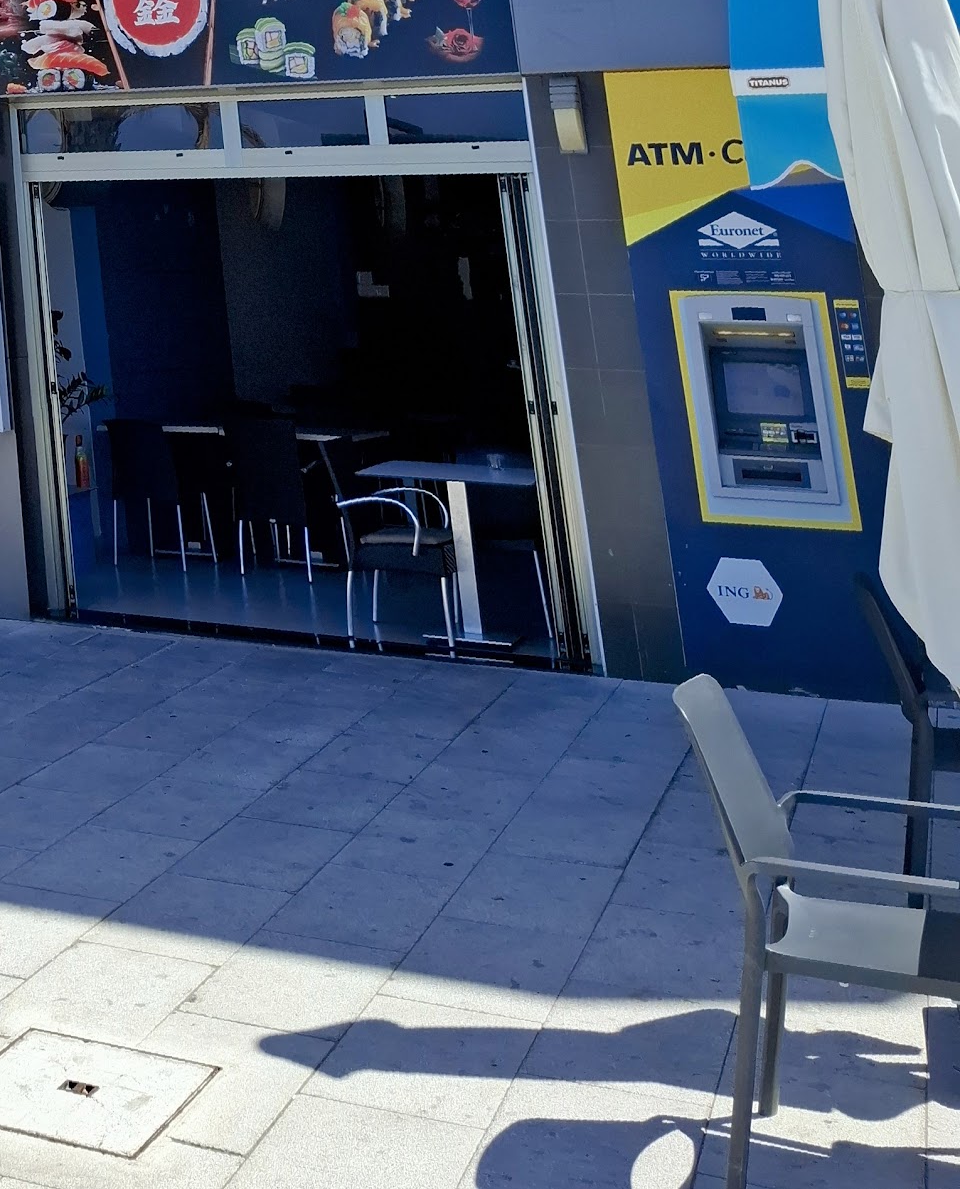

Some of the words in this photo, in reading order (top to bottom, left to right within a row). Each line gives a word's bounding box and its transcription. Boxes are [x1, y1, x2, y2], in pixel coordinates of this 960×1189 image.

[749, 76, 789, 88] TITANUS
[709, 223, 764, 237] Euronet
[700, 251, 782, 259] WORLDWIDE
[718, 585, 749, 599] ING
